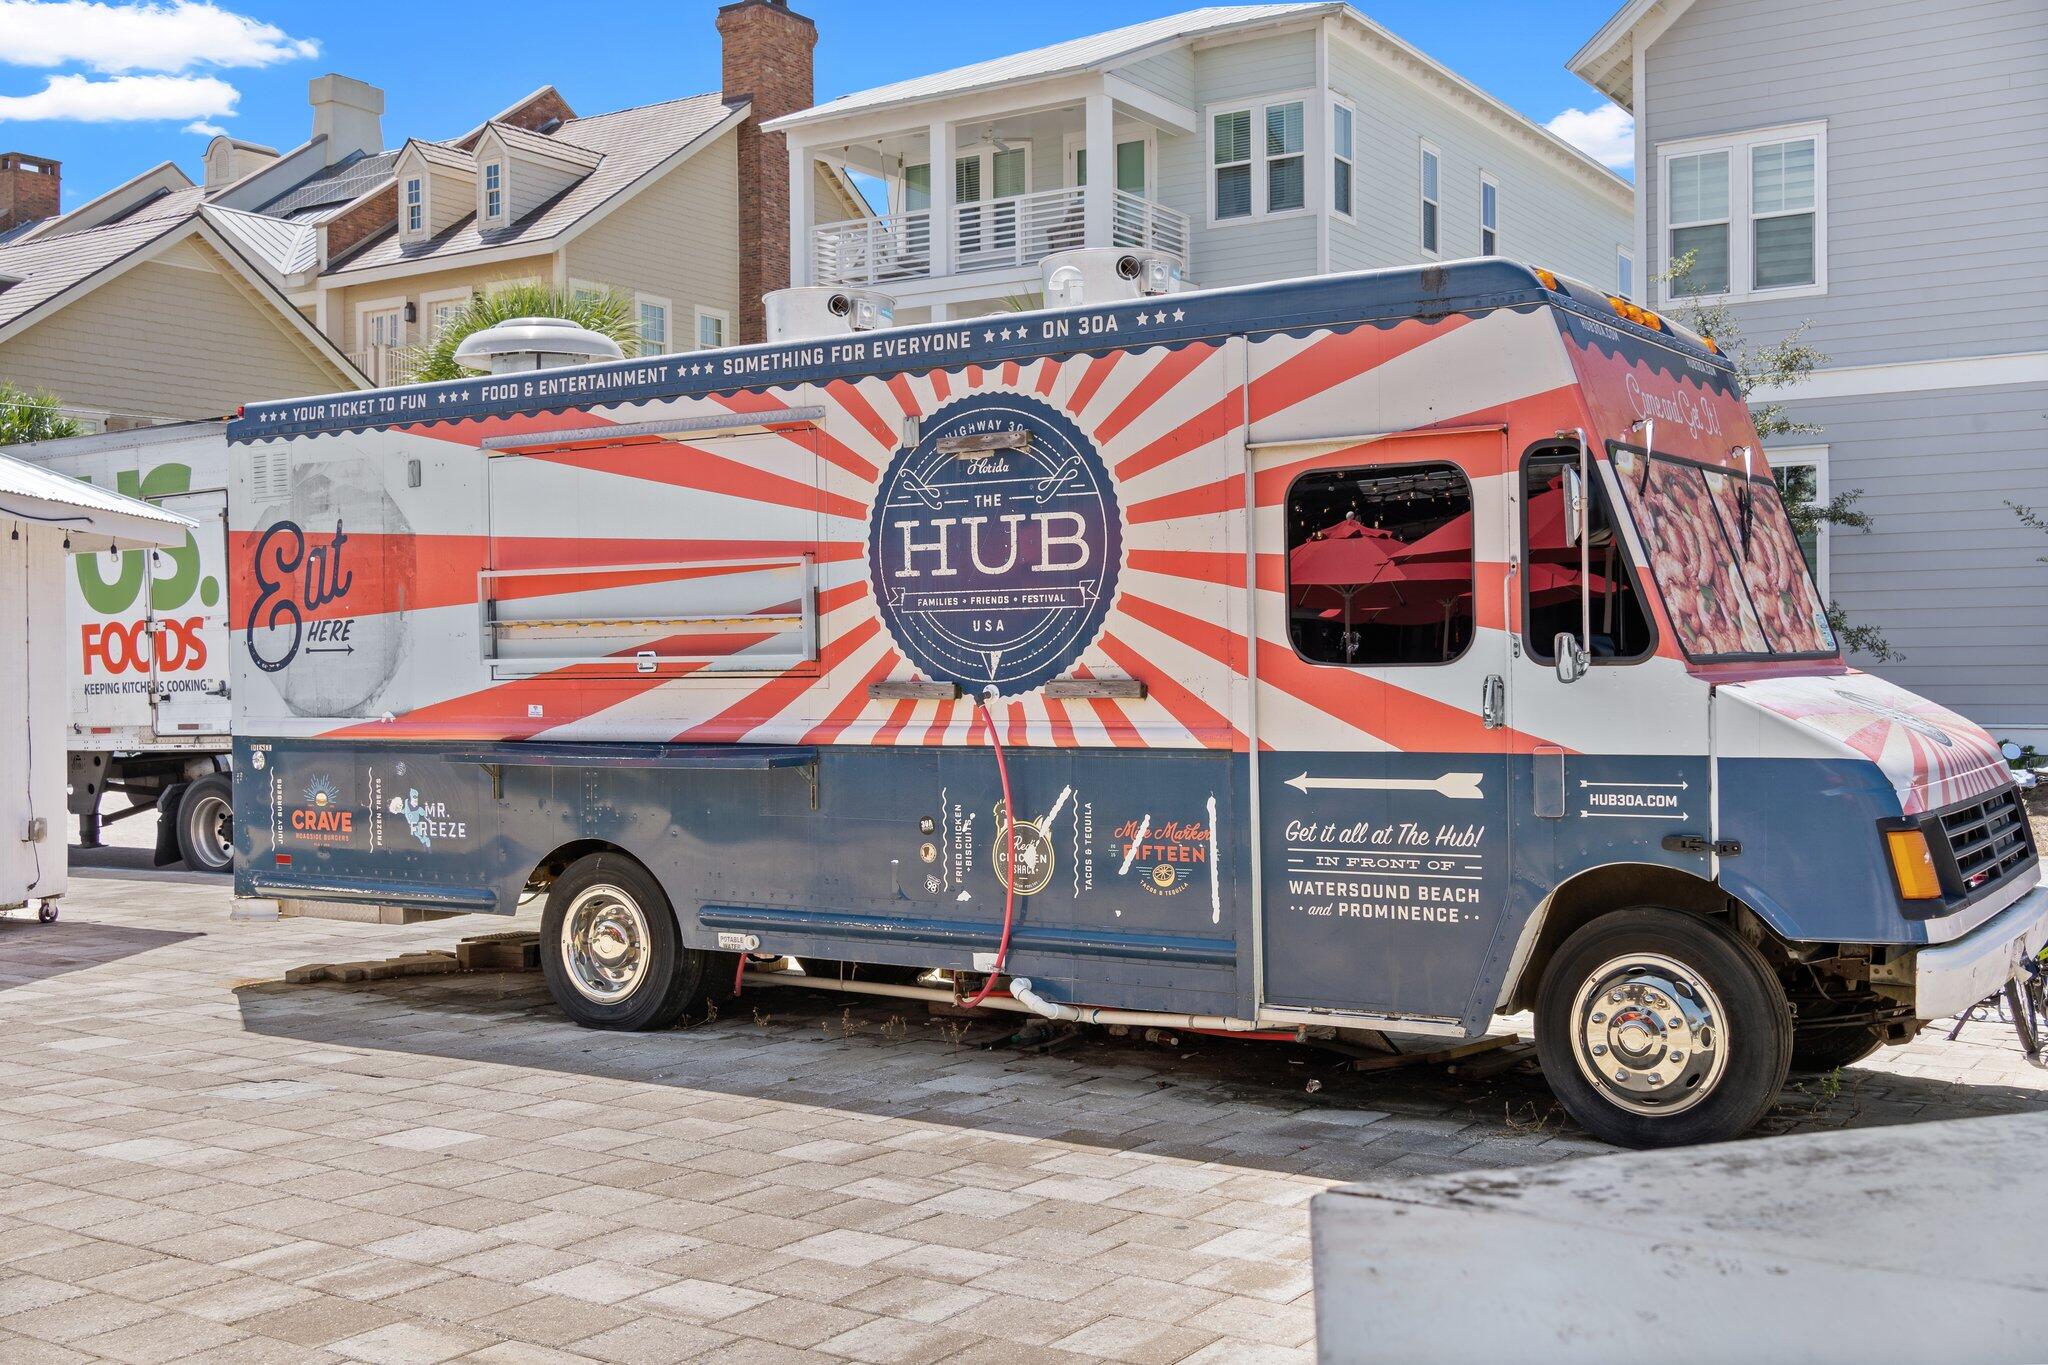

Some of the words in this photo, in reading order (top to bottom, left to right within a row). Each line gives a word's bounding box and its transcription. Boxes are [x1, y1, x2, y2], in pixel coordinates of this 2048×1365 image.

[1042, 318, 1069, 340] ON
[1078, 314, 1119, 335] 30A
[723, 347, 824, 376] SOMETHING
[831, 340, 865, 363] FOR
[873, 330, 972, 359] EVERYONE
[481, 382, 519, 402] FOOD
[524, 381, 534, 397] &
[539, 366, 668, 395] ENTERTAINMENT
[293, 405, 325, 422] YOUR
[330, 400, 375, 419] TICKET
[379, 397, 396, 413] TO
[400, 393, 427, 411] FUN
[1626, 373, 1664, 419] Come
[1661, 391, 1684, 424] and
[1678, 390, 1704, 440] Get
[1008, 421, 1029, 433] 30
[967, 457, 1010, 475] Florida
[974, 493, 1002, 508] THE
[894, 511, 1091, 578] HUB
[247, 519, 352, 673] Eat
[917, 597, 959, 607] FAMILIES
[970, 595, 1010, 605] FRIENDS
[1021, 593, 1066, 604] FESTIVAL
[307, 620, 354, 642] HERE
[972, 619, 1005, 632] USA
[81, 616, 208, 675] FOODS
[84, 682, 120, 695] KEEPING
[424, 802, 450, 818] MR.
[1589, 794, 1678, 808] HUB30A.COM
[291, 809, 352, 833] CRAVE
[410, 821, 466, 838] FREEZE
[954, 804, 962, 850] CHICKEN
[1084, 803, 1092, 845] TEQUILA
[1114, 820, 1152, 840] Mie
[1285, 820, 1317, 842] Get
[1320, 822, 1336, 843] it
[1339, 822, 1369, 844] all
[1371, 825, 1393, 845] at
[1398, 823, 1430, 846] The
[1435, 824, 1485, 848] Hub!
[955, 853, 963, 883] FRIED
[1316, 856, 1339, 866] IN
[1346, 858, 1420, 870] FRONT
[1427, 861, 1455, 871] OF
[925, 881, 937, 892] 98
[1140, 880, 1156, 894] TACOS
[1165, 882, 1188, 895] TEQUILA
[1289, 880, 1410, 900] WATERSOUND
[1418, 886, 1480, 903] BEACH
[1308, 903, 1333, 916] and
[1338, 902, 1459, 923] PROMINENCE
